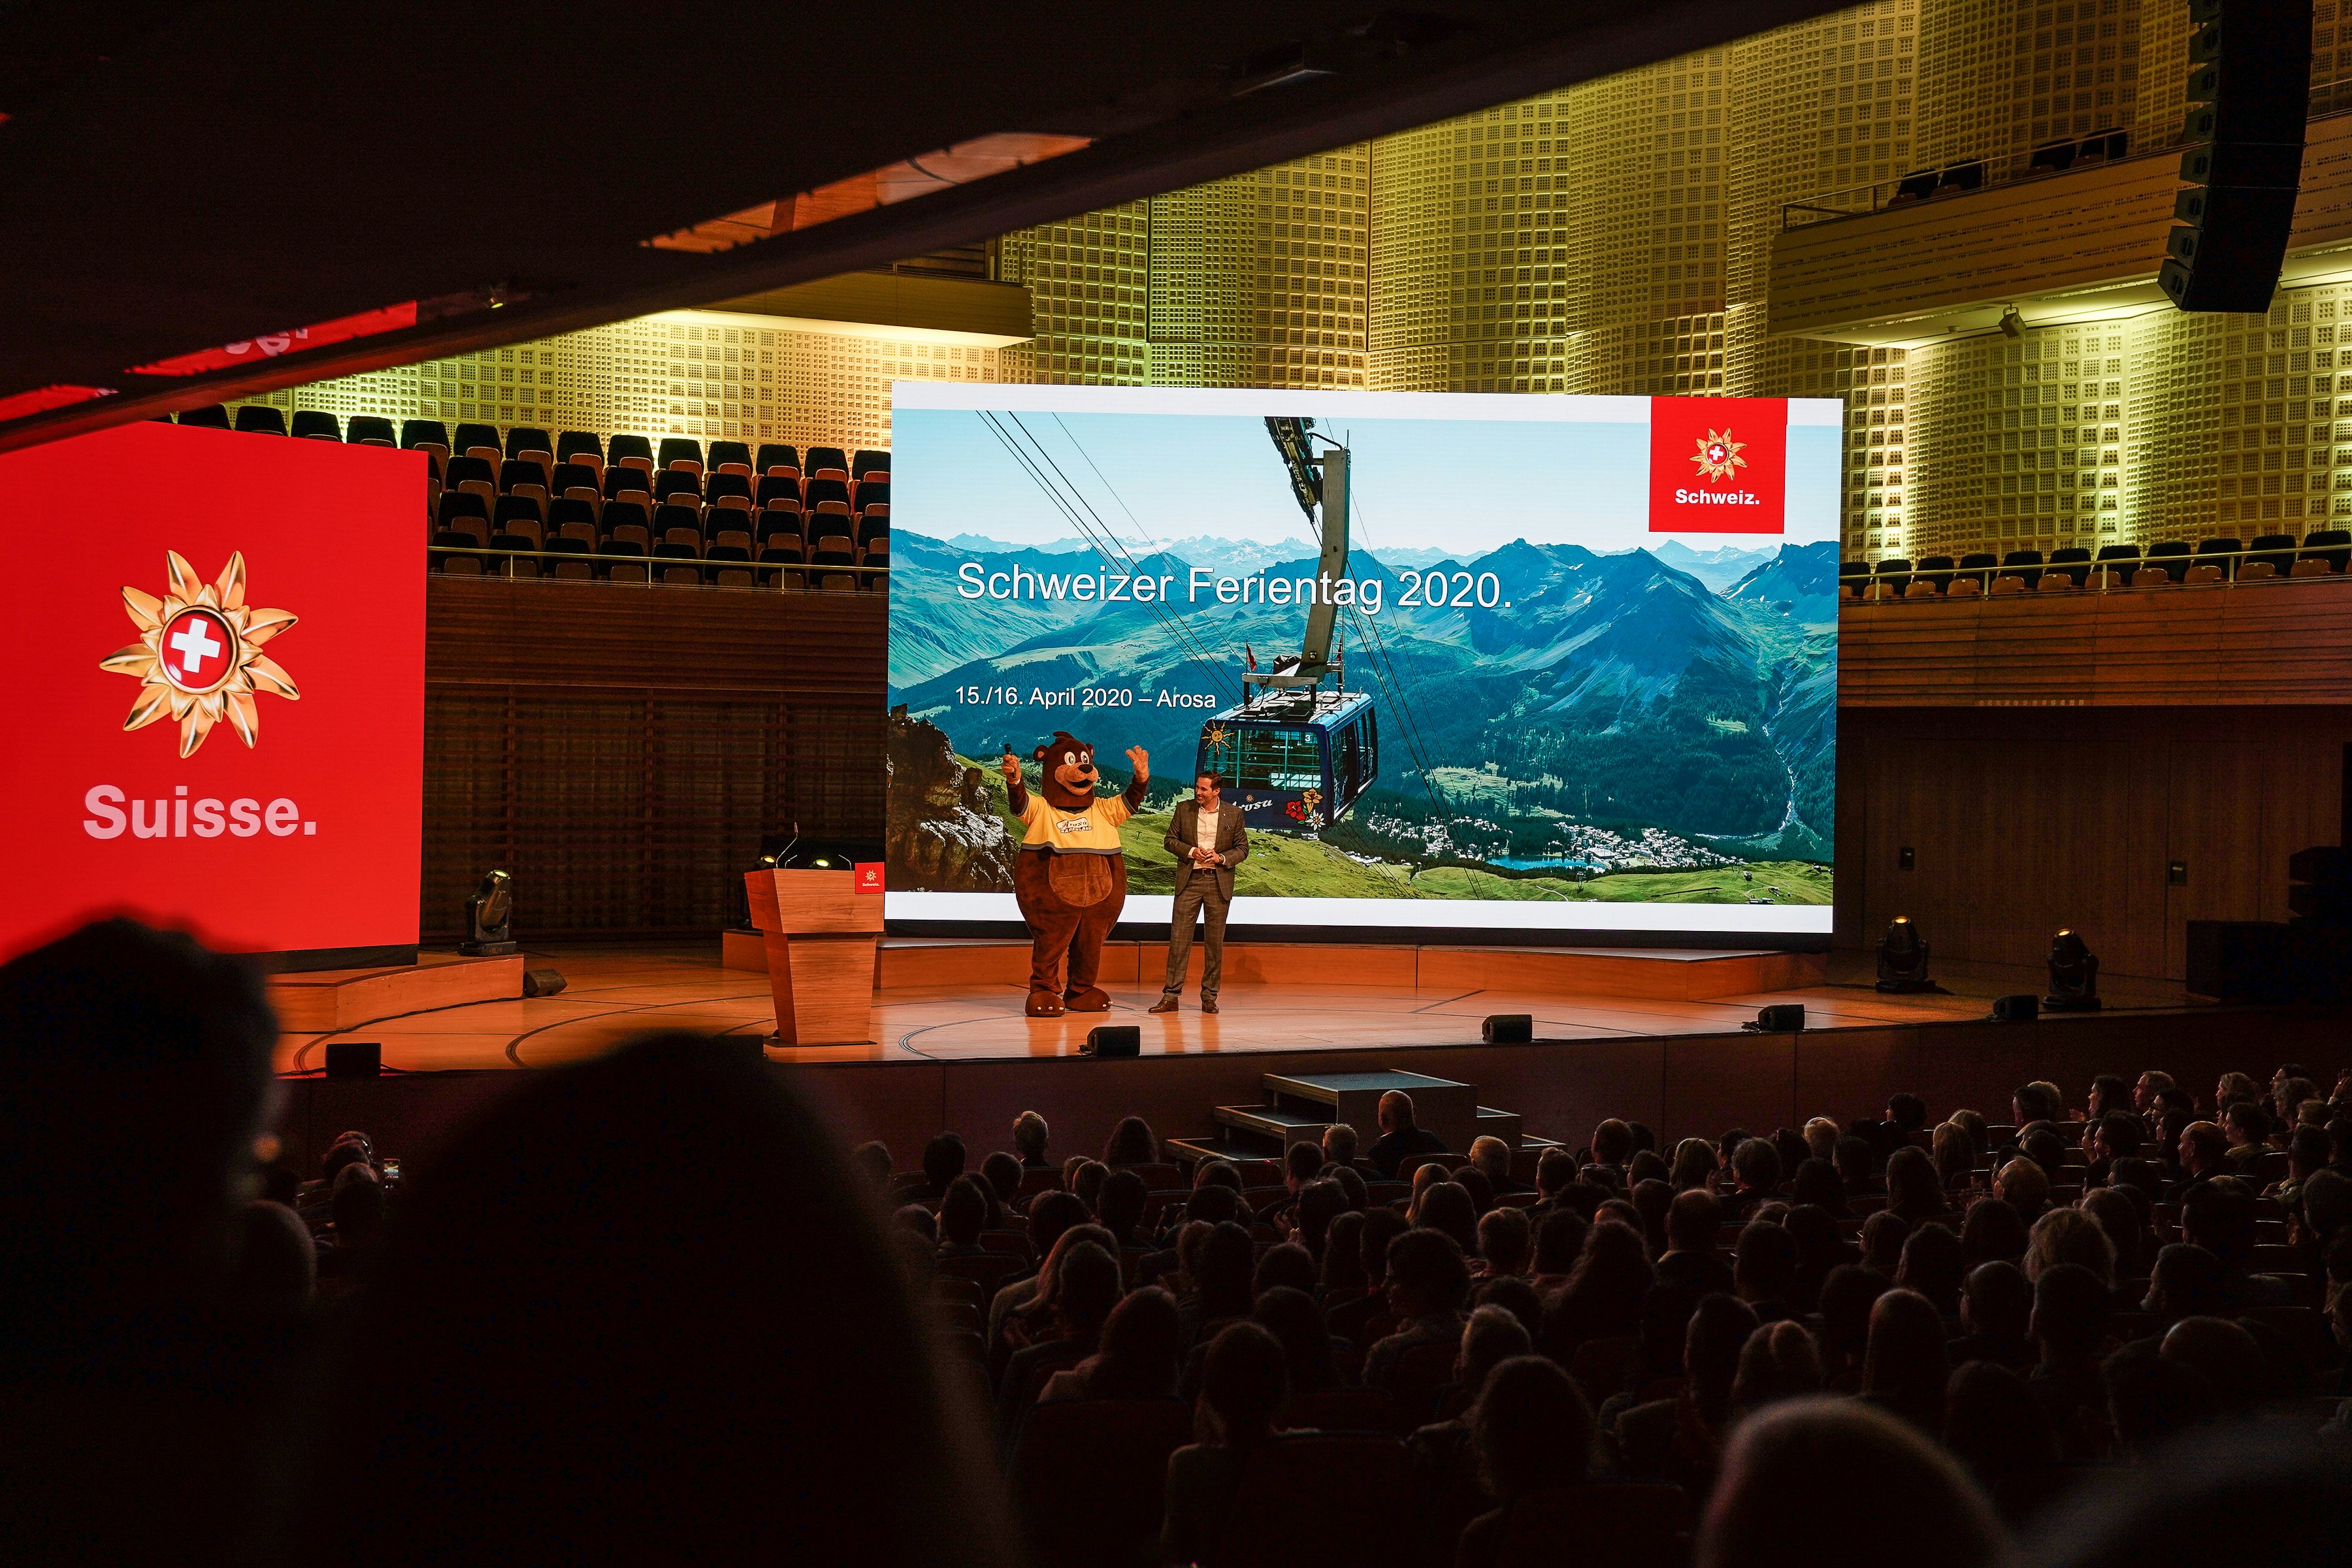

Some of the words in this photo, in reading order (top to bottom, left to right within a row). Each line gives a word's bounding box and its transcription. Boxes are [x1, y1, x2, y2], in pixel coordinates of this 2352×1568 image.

[1675, 488, 1760, 505] Schweiz.
[956, 561, 1175, 602] Schweizer
[1188, 566, 1383, 615] Ferientag
[1397, 570, 1512, 608] 2020.
[955, 685, 1023, 705] 15./16.
[1028, 687, 1075, 710] April
[1081, 687, 1133, 707] 2020
[1156, 689, 1217, 708] Arosa
[83, 784, 317, 840] Suisse.
